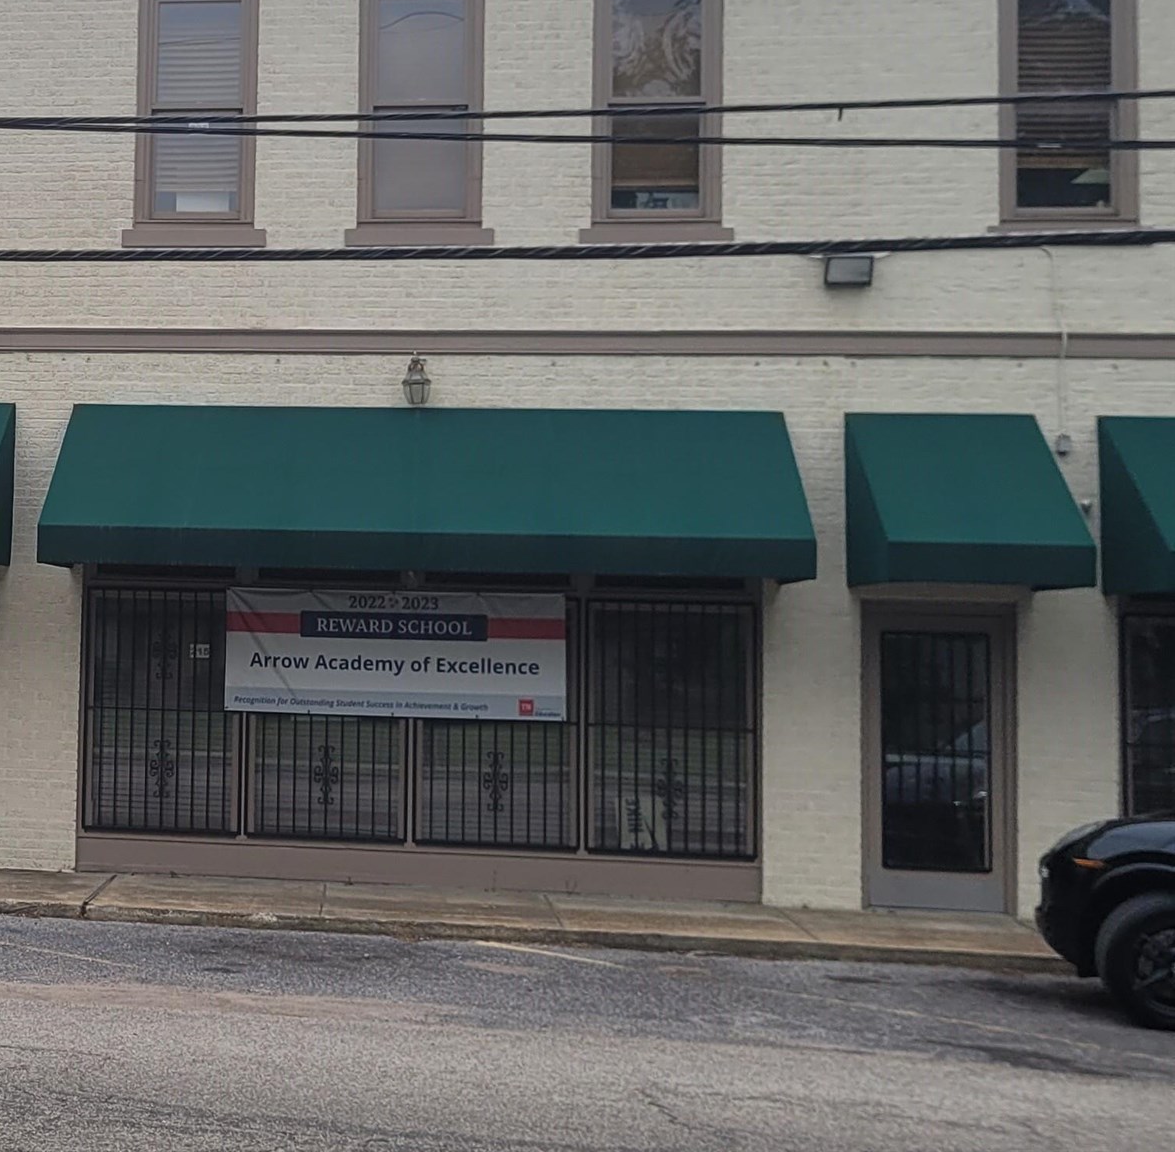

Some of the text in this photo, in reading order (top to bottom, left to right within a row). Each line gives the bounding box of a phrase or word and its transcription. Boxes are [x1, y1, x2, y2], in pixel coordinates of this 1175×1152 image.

[348, 595, 439, 610] 2022 2023
[316, 617, 472, 635] REWARD SCHOOL
[250, 652, 540, 676] Arrow Academy of Excellence
[234, 695, 275, 706] Recognition
[276, 696, 288, 706] for
[290, 697, 334, 708] Outstanding
[336, 698, 364, 708] Student
[366, 699, 394, 709] Success
[395, 701, 403, 709] in
[404, 701, 451, 710] Achievement
[461, 702, 488, 712] Growth
